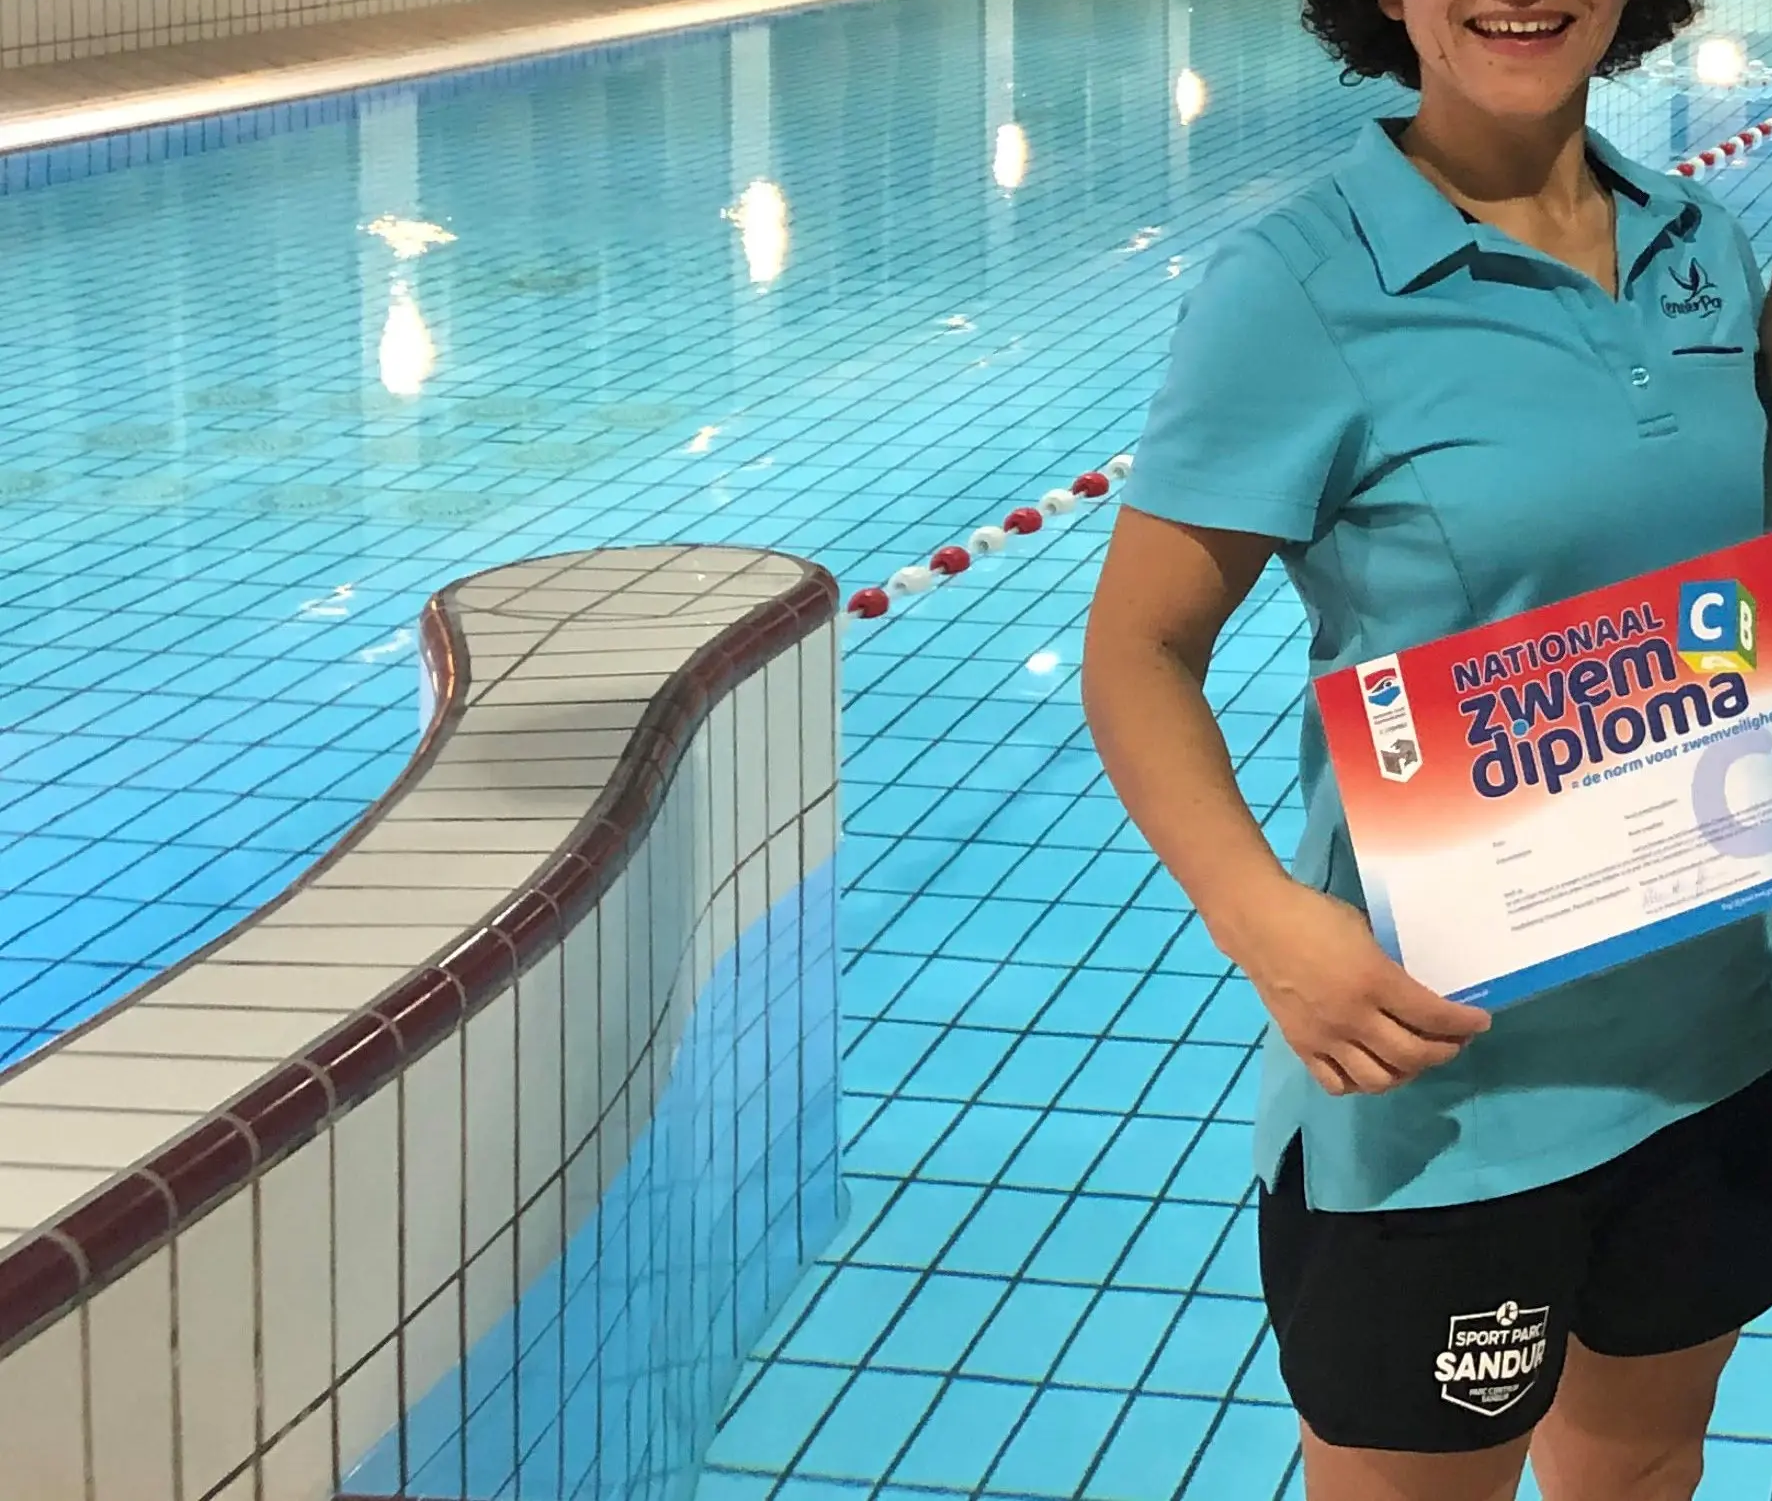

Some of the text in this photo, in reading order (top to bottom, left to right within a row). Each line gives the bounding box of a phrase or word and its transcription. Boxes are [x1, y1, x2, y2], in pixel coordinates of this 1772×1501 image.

[1689, 592, 1725, 641] C
[1452, 603, 1664, 692] NATIONAAL
[1459, 637, 1677, 746] zwem
[1471, 671, 1750, 798] diploma
[1582, 772, 1602, 787] de
[1603, 759, 1644, 780] norm
[1645, 745, 1679, 766] voor
[1455, 1322, 1545, 1348] SPORT PARC
[1433, 1338, 1547, 1383] SANDUR
